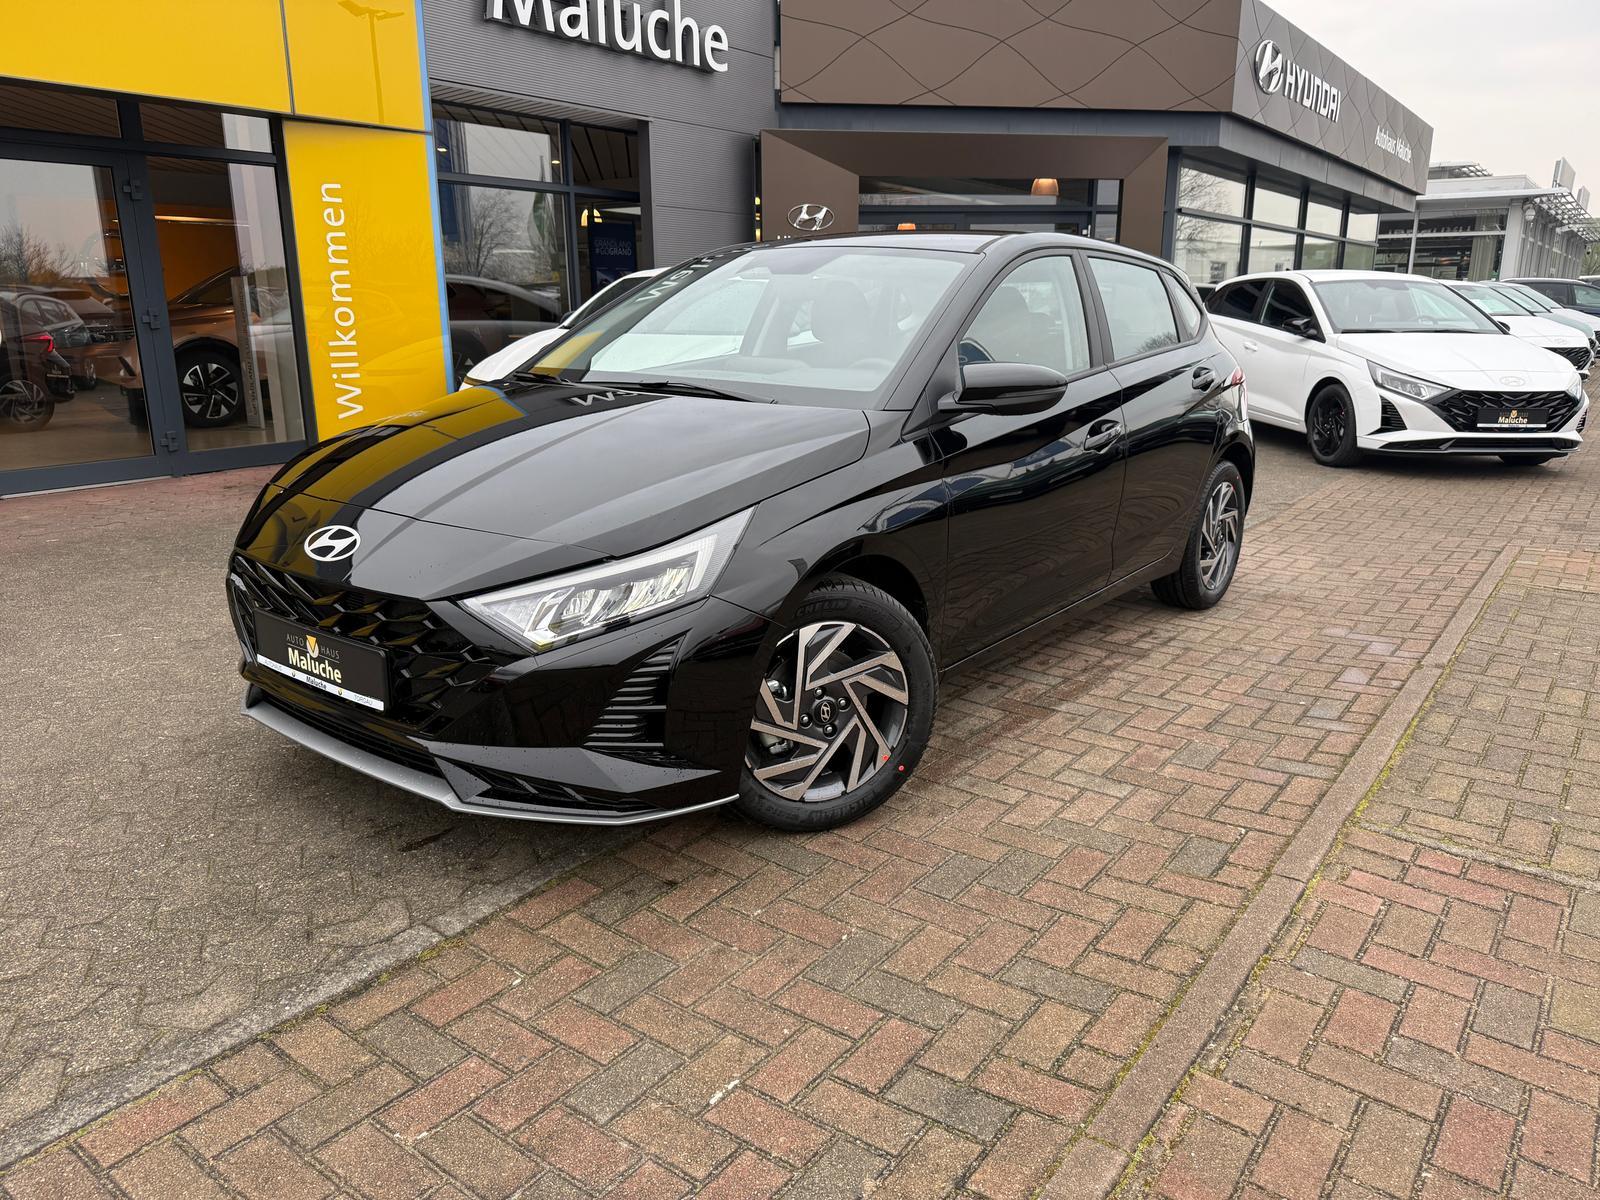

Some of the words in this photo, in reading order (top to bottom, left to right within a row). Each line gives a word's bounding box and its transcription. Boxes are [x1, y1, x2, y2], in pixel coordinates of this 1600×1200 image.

[490, 0, 729, 72] Maluche
[1284, 59, 1341, 123] HYUNDAI
[320, 183, 365, 420] Willkommen
[286, 633, 304, 647] AUTO
[287, 647, 342, 683] Maluche
[320, 645, 340, 660] HAUS
